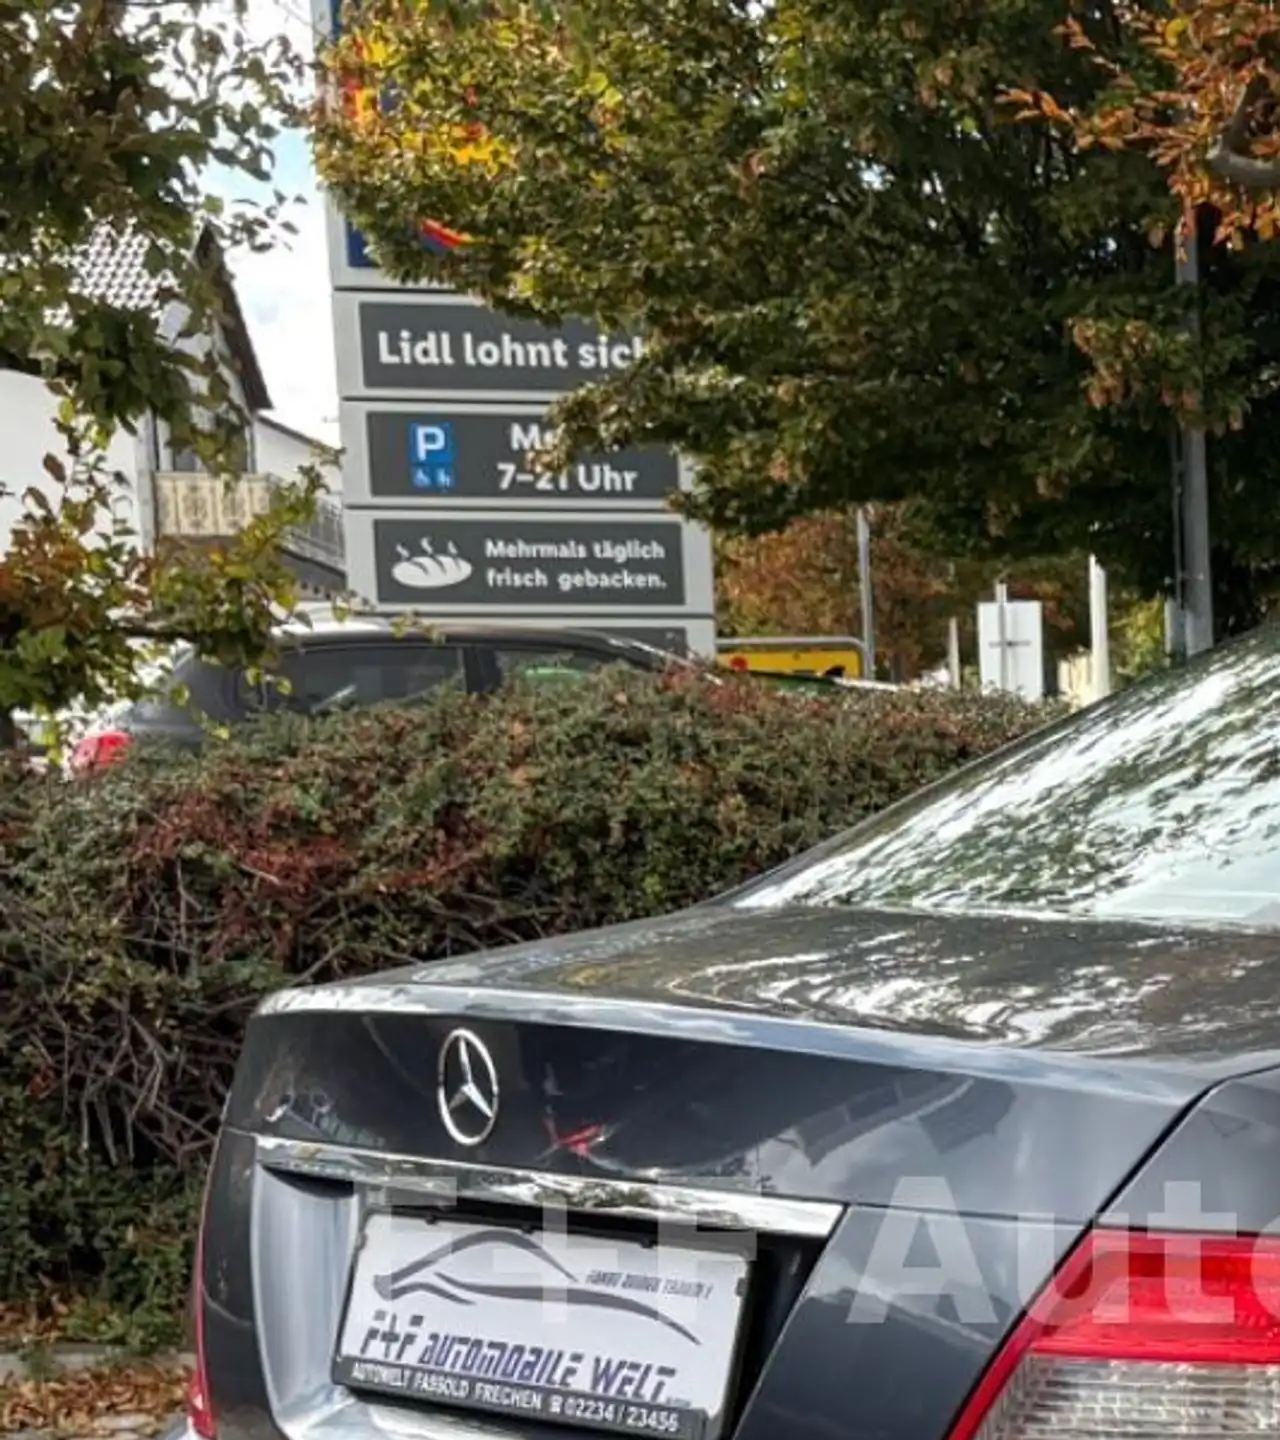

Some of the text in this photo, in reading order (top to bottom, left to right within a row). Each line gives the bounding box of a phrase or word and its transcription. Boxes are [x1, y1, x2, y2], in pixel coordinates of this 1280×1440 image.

[378, 328, 455, 366] Lidl
[463, 331, 569, 368] lohnt
[416, 425, 446, 461] P
[577, 462, 640, 491] Uhr
[485, 537, 666, 563] Mehrmals täglich
[487, 565, 668, 592] frisch gebacken.
[589, 1355, 677, 1404] WELT
[473, 1381, 543, 1409] FRECHEN
